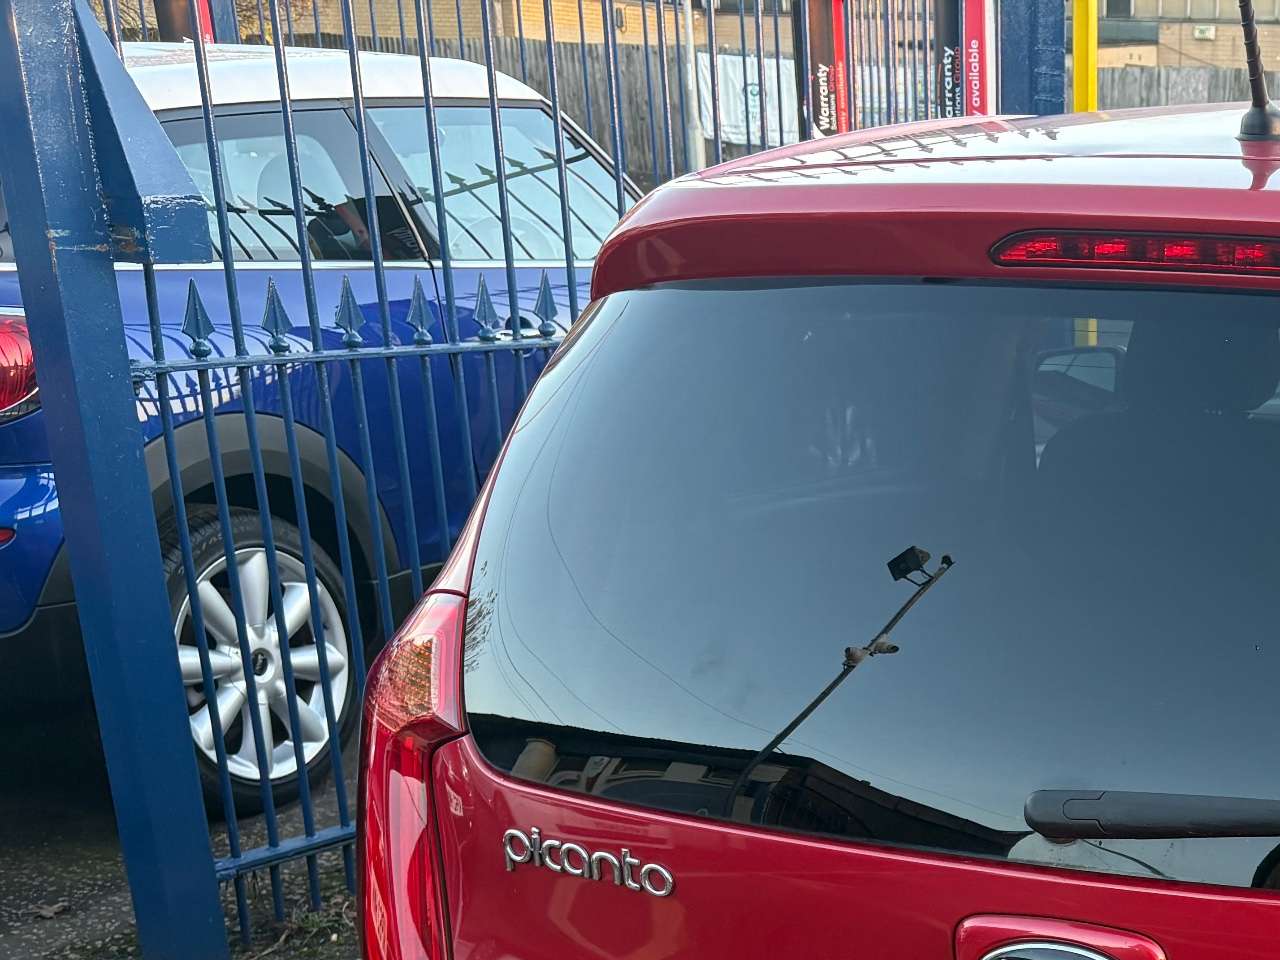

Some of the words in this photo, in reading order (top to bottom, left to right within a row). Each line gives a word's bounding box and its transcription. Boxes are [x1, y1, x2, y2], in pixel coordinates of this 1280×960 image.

[816, 63, 830, 130] Warranty
[943, 45, 955, 118] arranty
[969, 39, 980, 107] available
[502, 825, 675, 898] picanto
